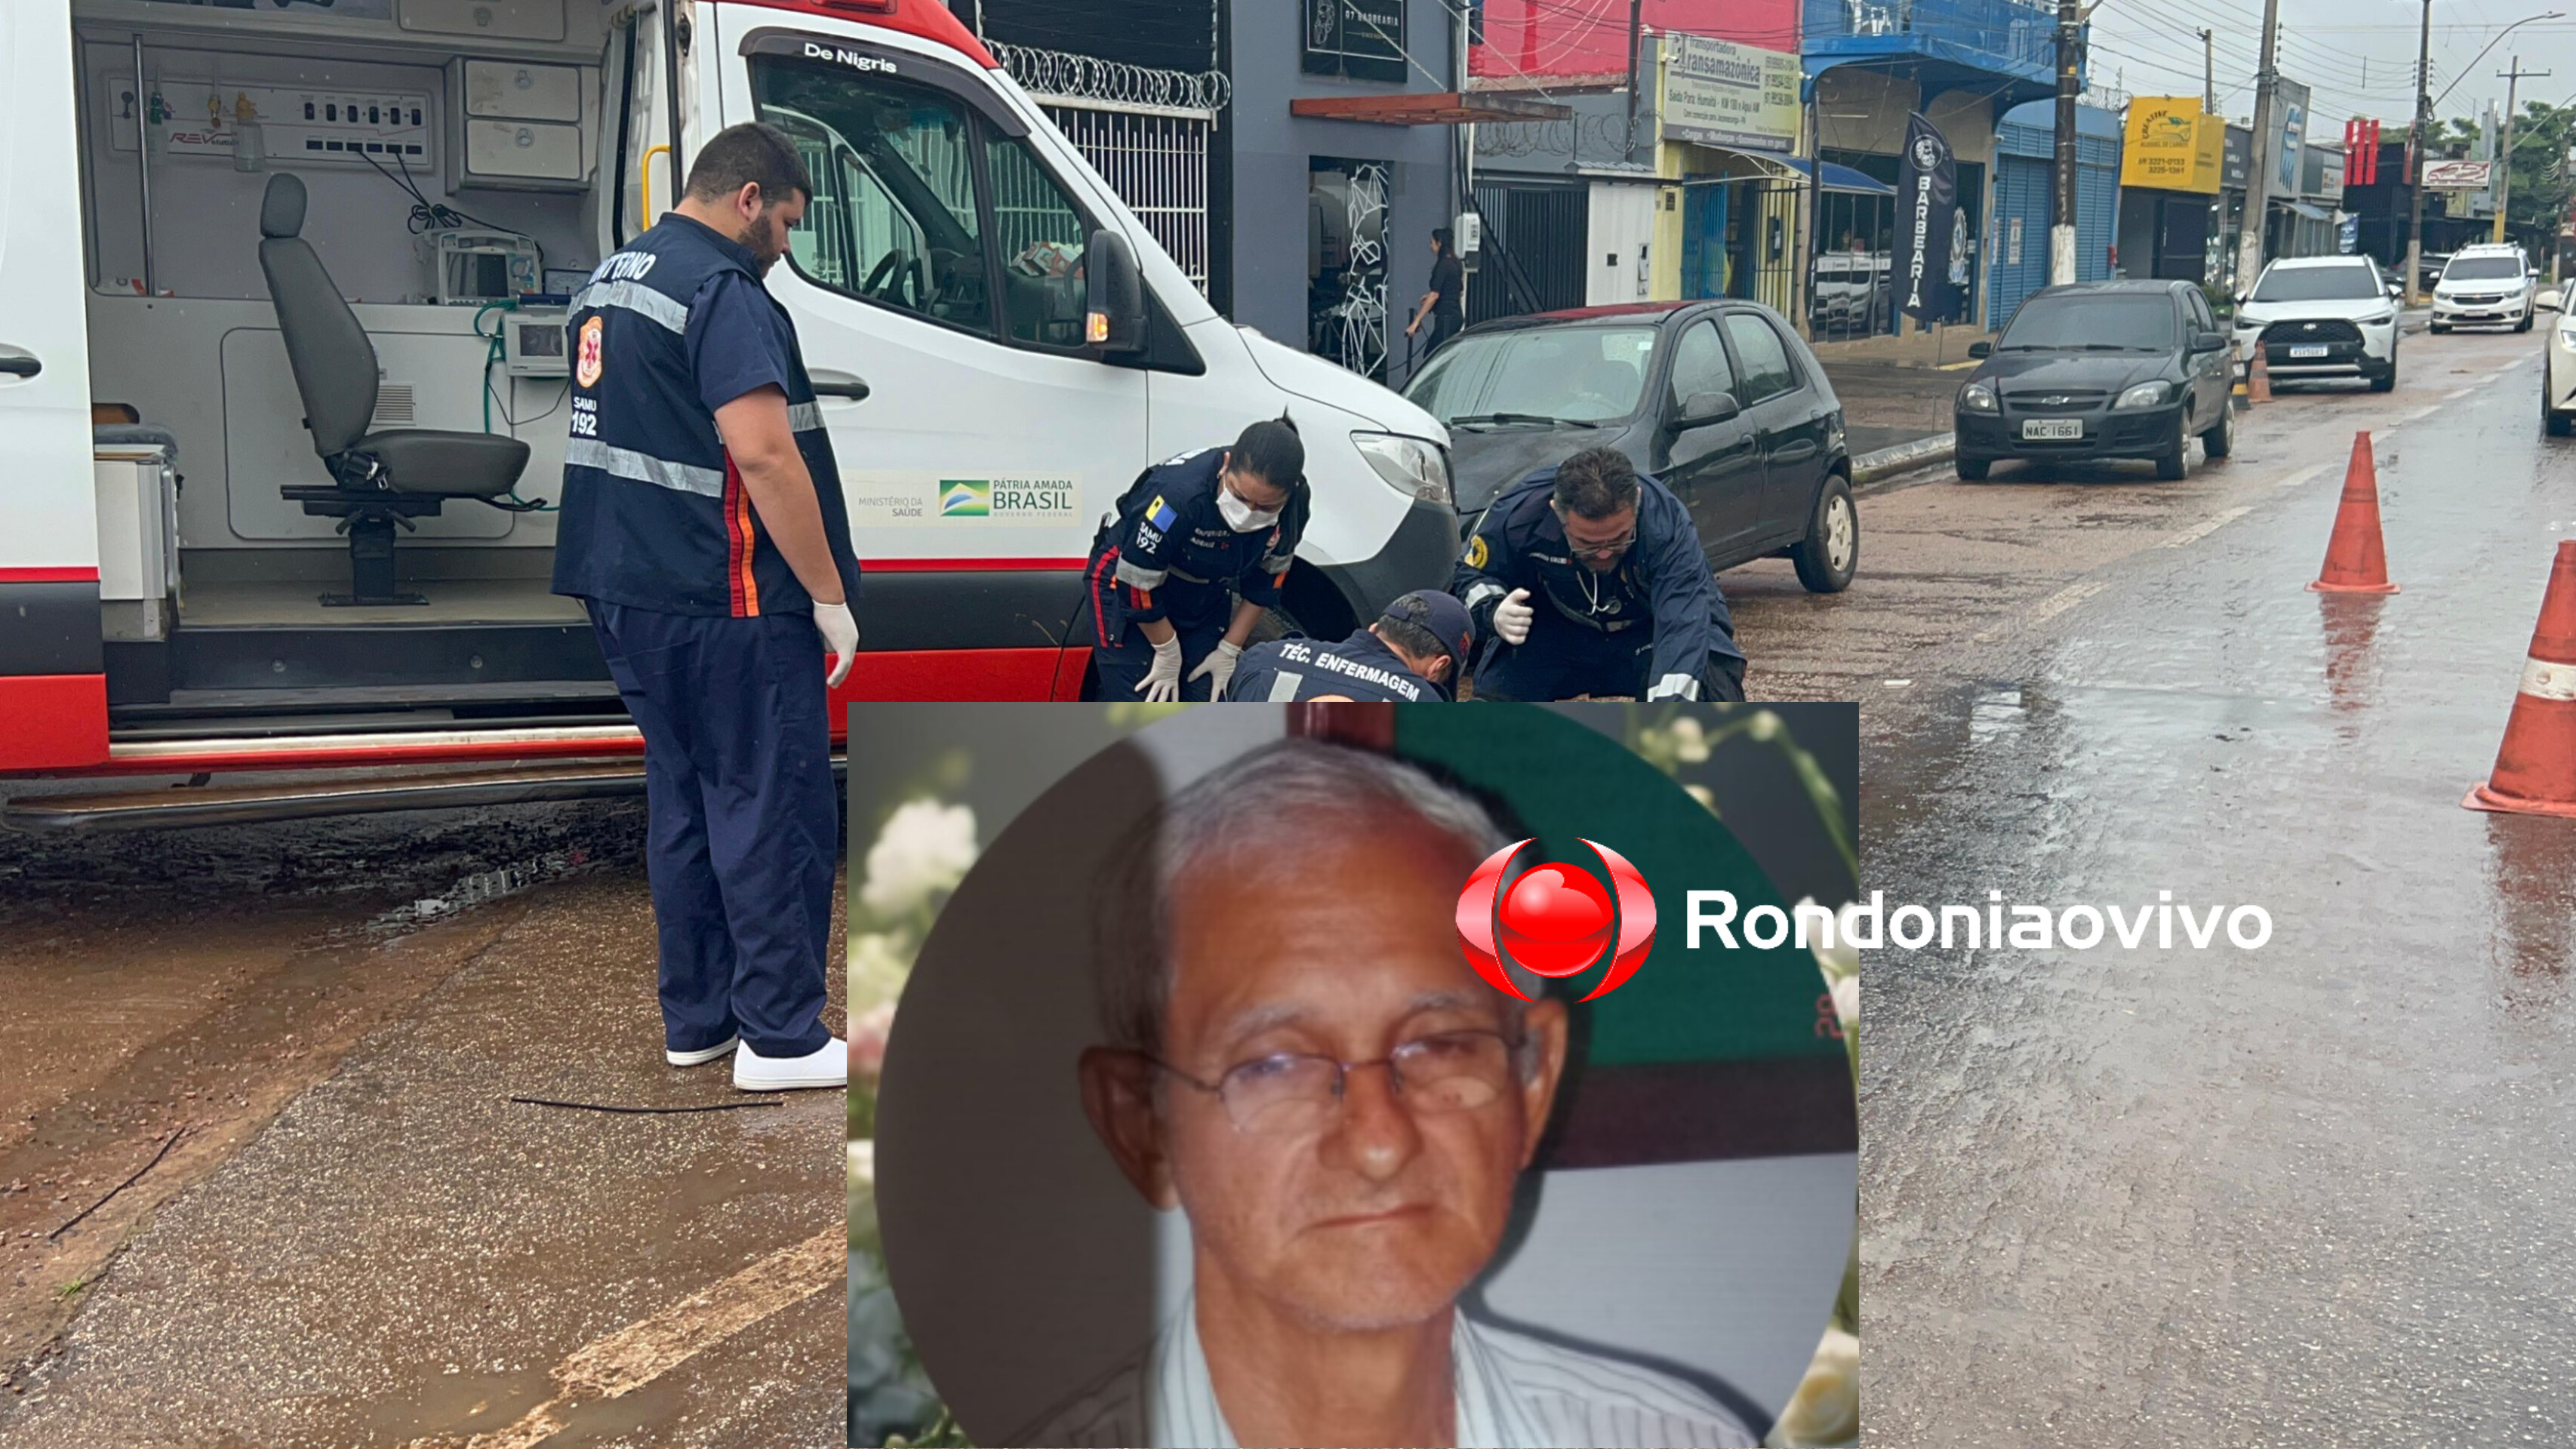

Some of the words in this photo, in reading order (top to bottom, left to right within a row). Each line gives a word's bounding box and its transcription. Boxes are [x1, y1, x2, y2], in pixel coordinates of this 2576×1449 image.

[1690, 37, 1736, 56] Transportadora
[805, 43, 833, 60] De
[837, 49, 897, 73] Nigris
[1907, 176, 1931, 308] BARBEARIA
[574, 396, 597, 411] SAMU
[571, 411, 597, 436] 192
[993, 477, 1030, 491] PÁTRIA
[1033, 480, 1073, 491] AMADA
[859, 495, 909, 507] MINISTÉRIO
[911, 498, 923, 507] DA
[993, 491, 1073, 509] BRASIL
[892, 507, 923, 517] SAÚDE
[1139, 521, 1163, 543] SAMU
[1136, 533, 1157, 555] 192
[1279, 643, 1311, 664] TÉC.
[1315, 652, 1420, 701] ENFERMAGEM
